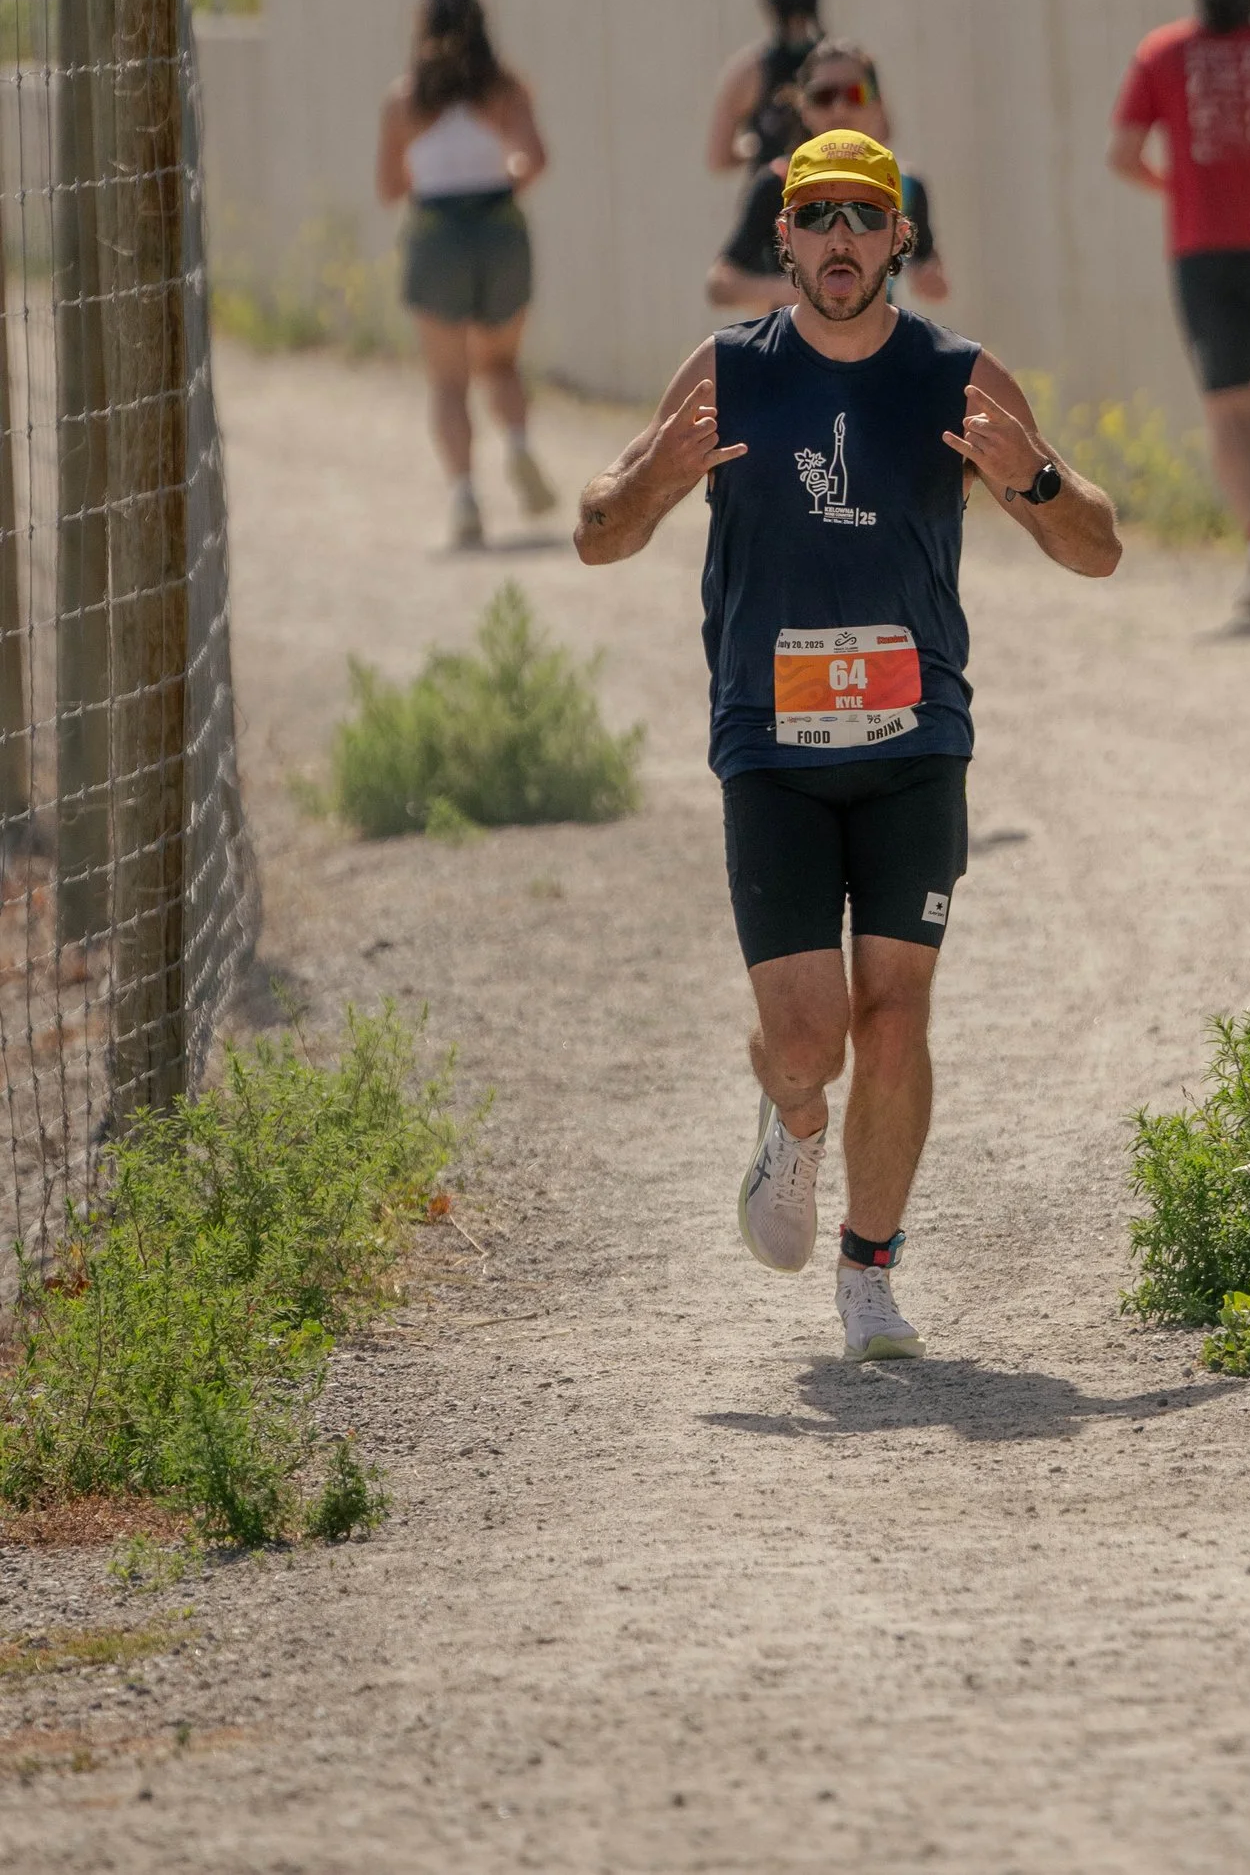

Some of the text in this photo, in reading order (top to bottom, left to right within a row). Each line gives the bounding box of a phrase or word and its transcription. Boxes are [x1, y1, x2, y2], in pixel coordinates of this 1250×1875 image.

[820, 143, 865, 155] GO ONE
[827, 151, 859, 161] MORE
[860, 512, 876, 525] 25
[778, 640, 791, 649] July
[792, 641, 803, 649] 20,
[829, 659, 868, 690] 64
[835, 696, 864, 709] KYLE
[867, 718, 904, 741] DRINK
[797, 731, 830, 744] FOOD
